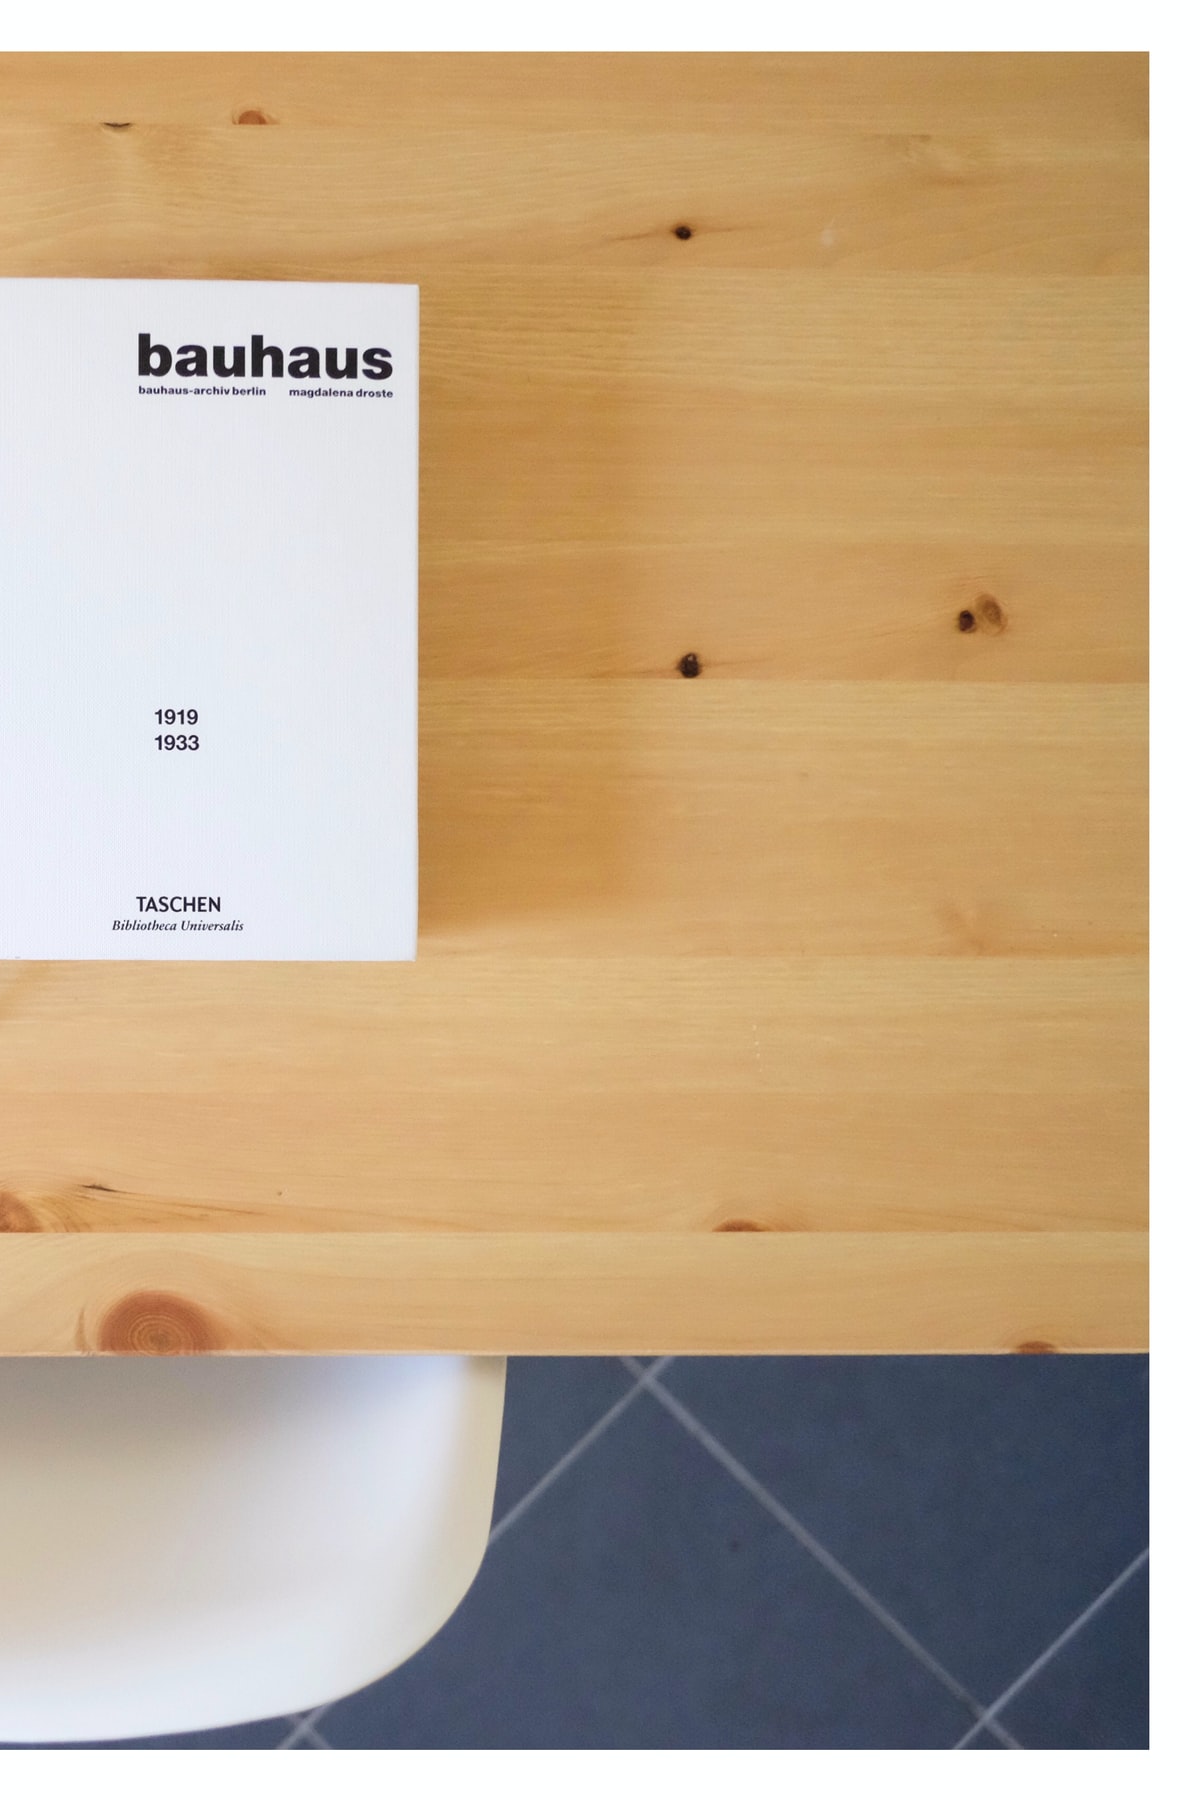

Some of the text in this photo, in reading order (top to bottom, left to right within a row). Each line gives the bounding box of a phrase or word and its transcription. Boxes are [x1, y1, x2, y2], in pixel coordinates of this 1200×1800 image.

[137, 332, 394, 381] bauhaus
[138, 385, 267, 397] bauhaus-archiv berlin
[288, 387, 394, 399] magdalena droste
[154, 708, 199, 726] 1919
[154, 734, 200, 751] 1933
[135, 895, 222, 913] TASCHEN
[111, 919, 244, 932] Bibliotheca Universalis
